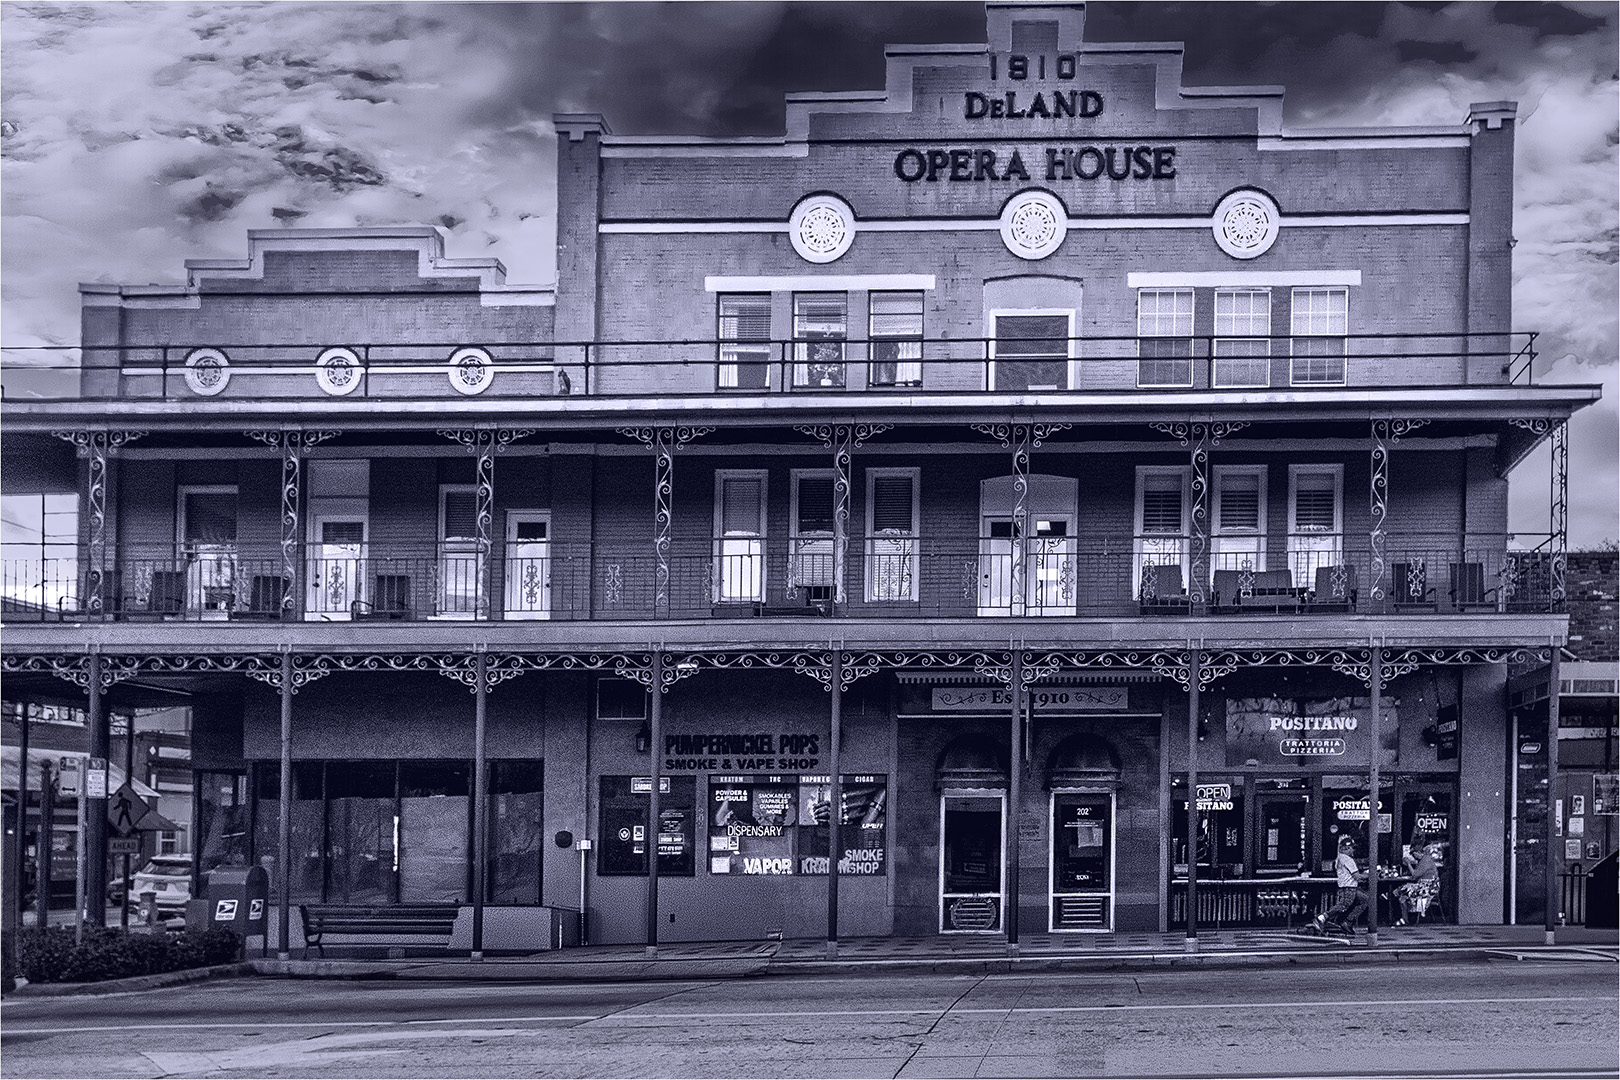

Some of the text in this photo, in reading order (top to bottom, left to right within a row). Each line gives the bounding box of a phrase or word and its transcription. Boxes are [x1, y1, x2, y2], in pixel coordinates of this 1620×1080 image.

[990, 54, 1076, 81] 1910
[894, 147, 1176, 182] OPERA HOUSE
[991, 690, 1025, 704] Es.
[1269, 716, 1358, 731] POSITANO
[665, 734, 820, 755] PUMPERNICKEL POPS
[665, 758, 819, 770] SMOKE & VAPE SHOP
[1196, 787, 1229, 798] OPEN
[1076, 807, 1090, 816] 202
[1183, 801, 1234, 811] PSITANO
[1417, 818, 1447, 830] OPEN
[727, 825, 783, 837] DISPENSARY
[112, 840, 137, 850] AHEAD
[844, 848, 884, 861] SMOKE
[743, 857, 793, 874] VAPOR
[801, 857, 850, 874] KRATM
[849, 861, 880, 874] SHOP
